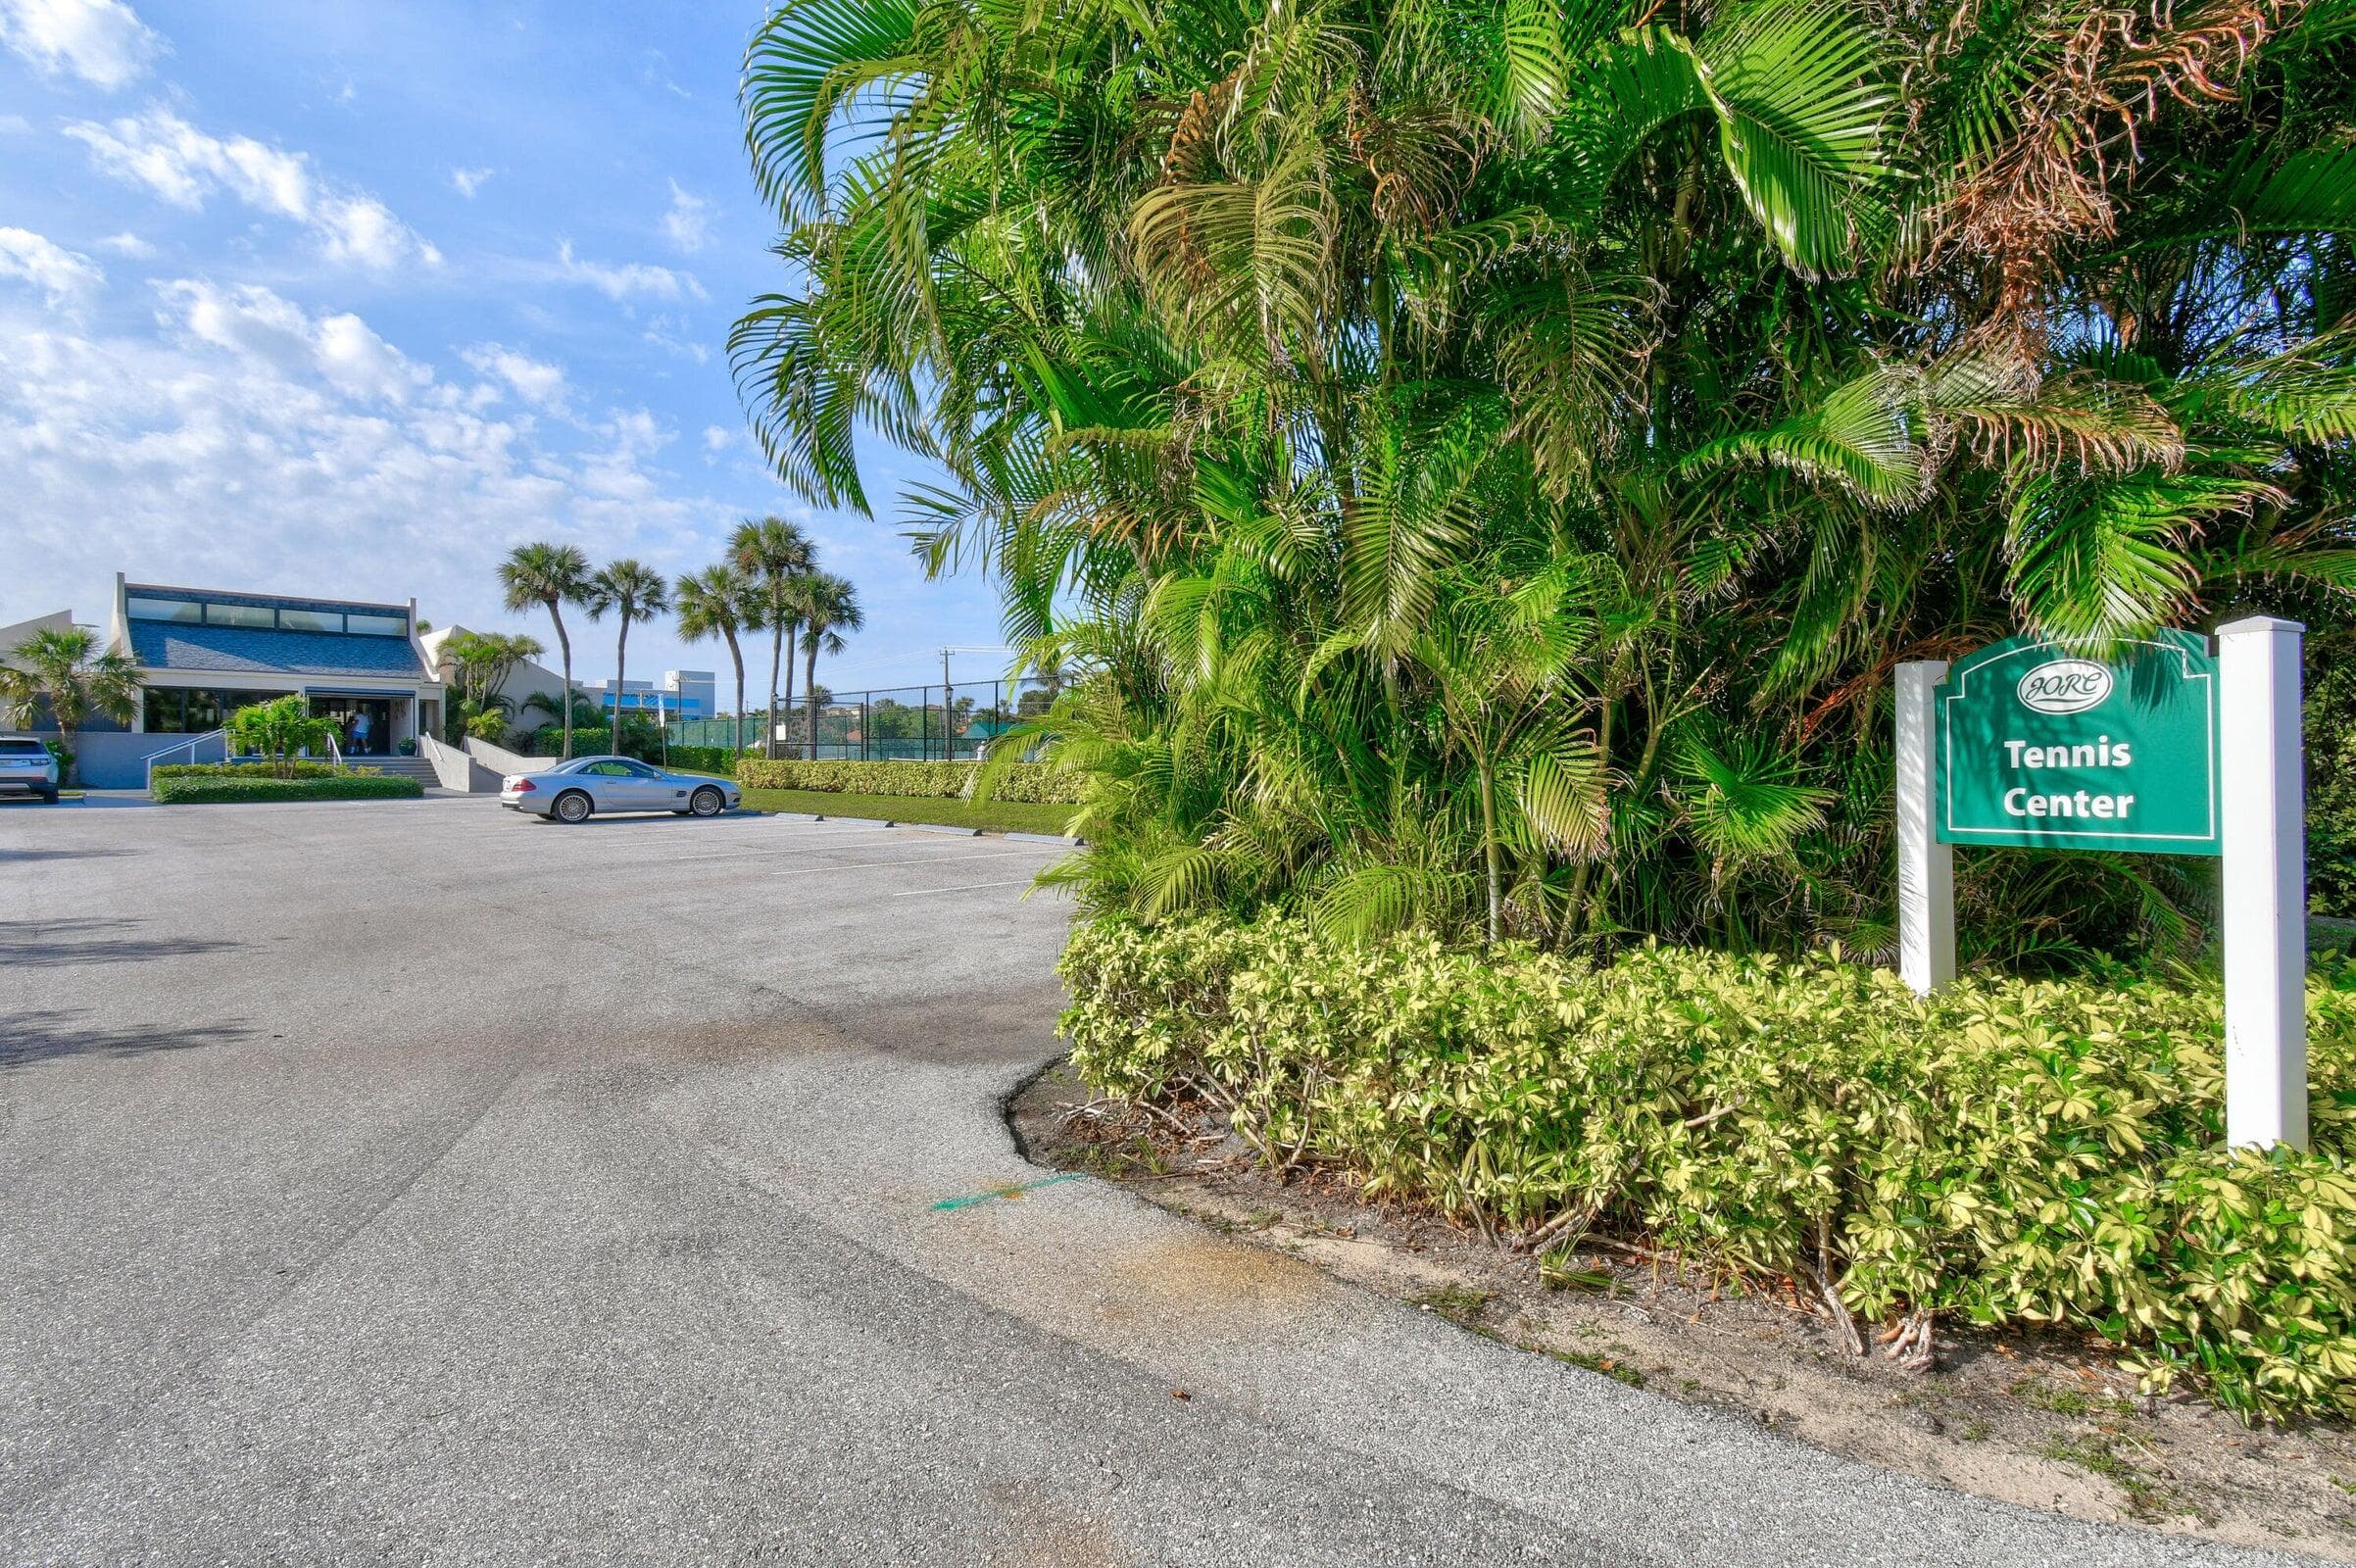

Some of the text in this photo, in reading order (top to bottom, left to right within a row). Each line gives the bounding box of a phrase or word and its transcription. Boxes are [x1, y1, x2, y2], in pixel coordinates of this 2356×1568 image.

[2025, 672, 2103, 700] JORC
[2004, 736, 2132, 768] Tennis
[2004, 787, 2135, 818] Center
